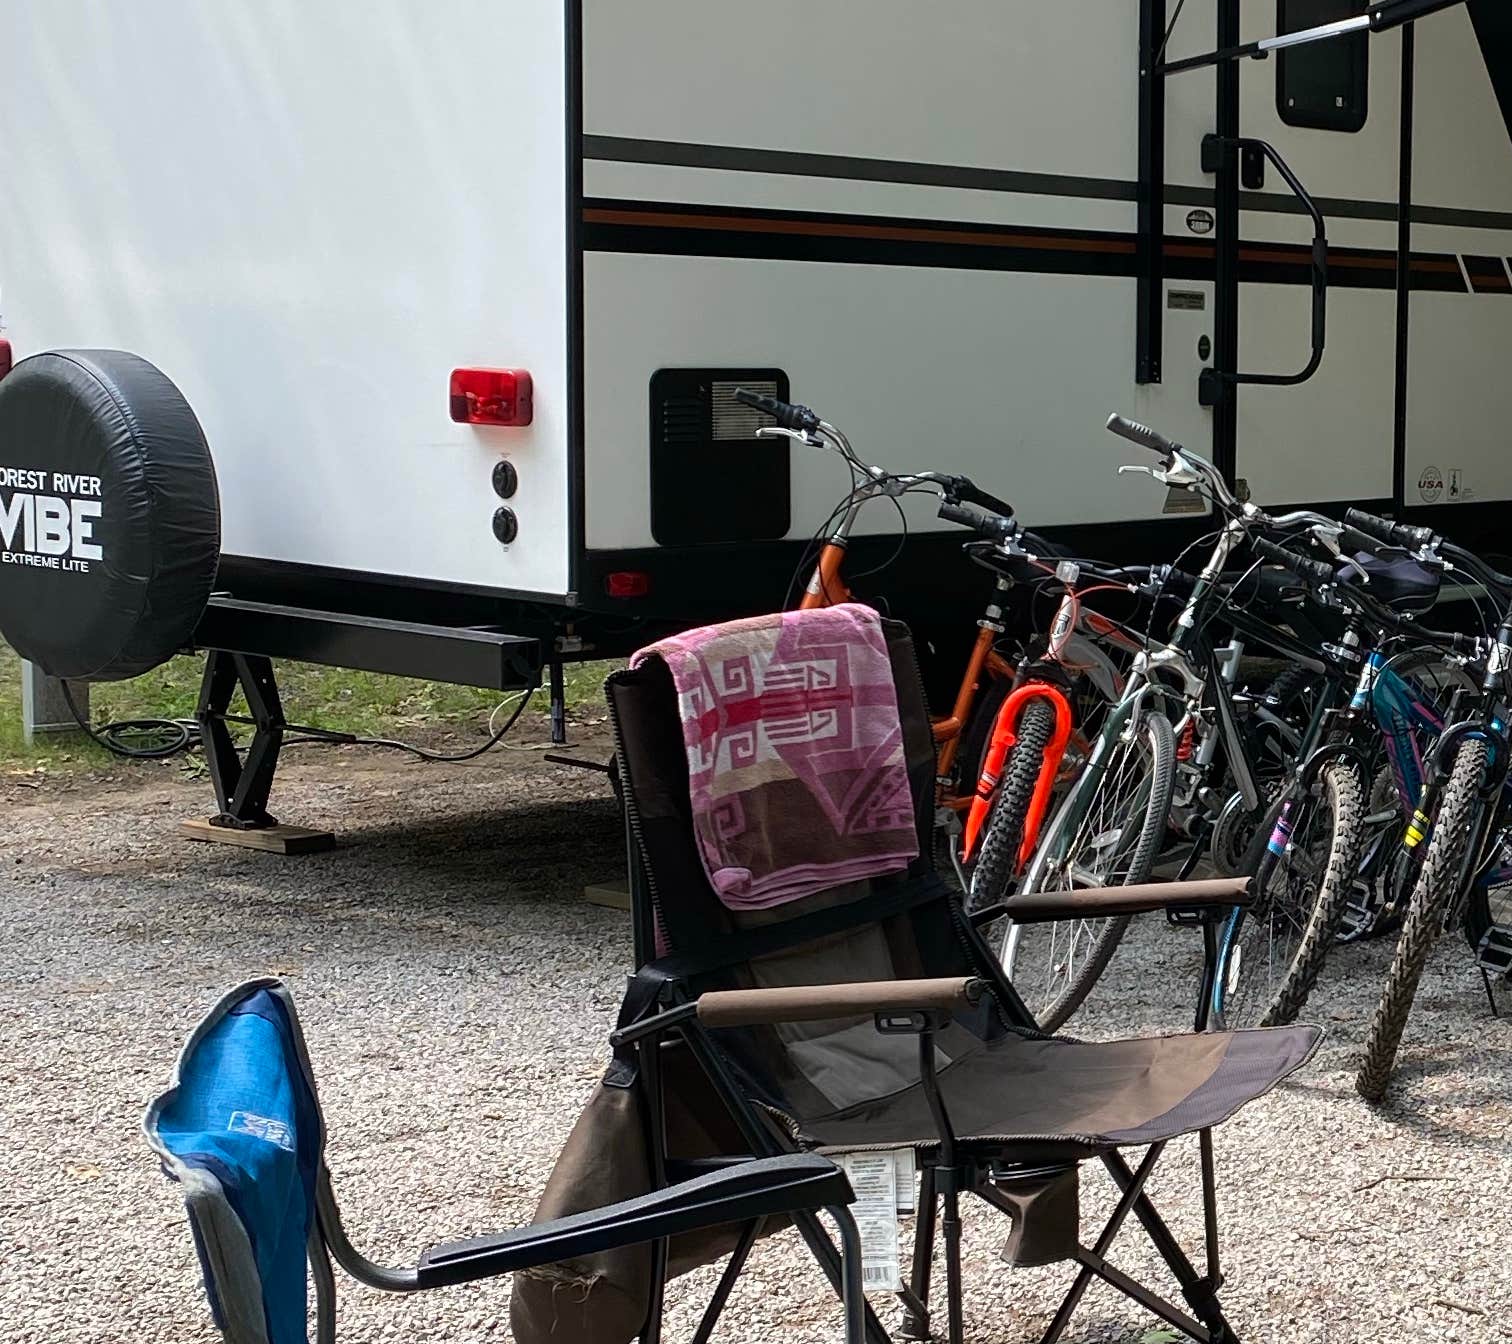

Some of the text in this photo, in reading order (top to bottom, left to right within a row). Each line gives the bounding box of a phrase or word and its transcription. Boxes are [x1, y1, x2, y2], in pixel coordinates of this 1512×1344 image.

[0, 467, 102, 496] OREST RIVER
[1418, 480, 1444, 489] USA
[0, 492, 103, 561] VIBE
[1, 551, 90, 573] EXTREME LITE
